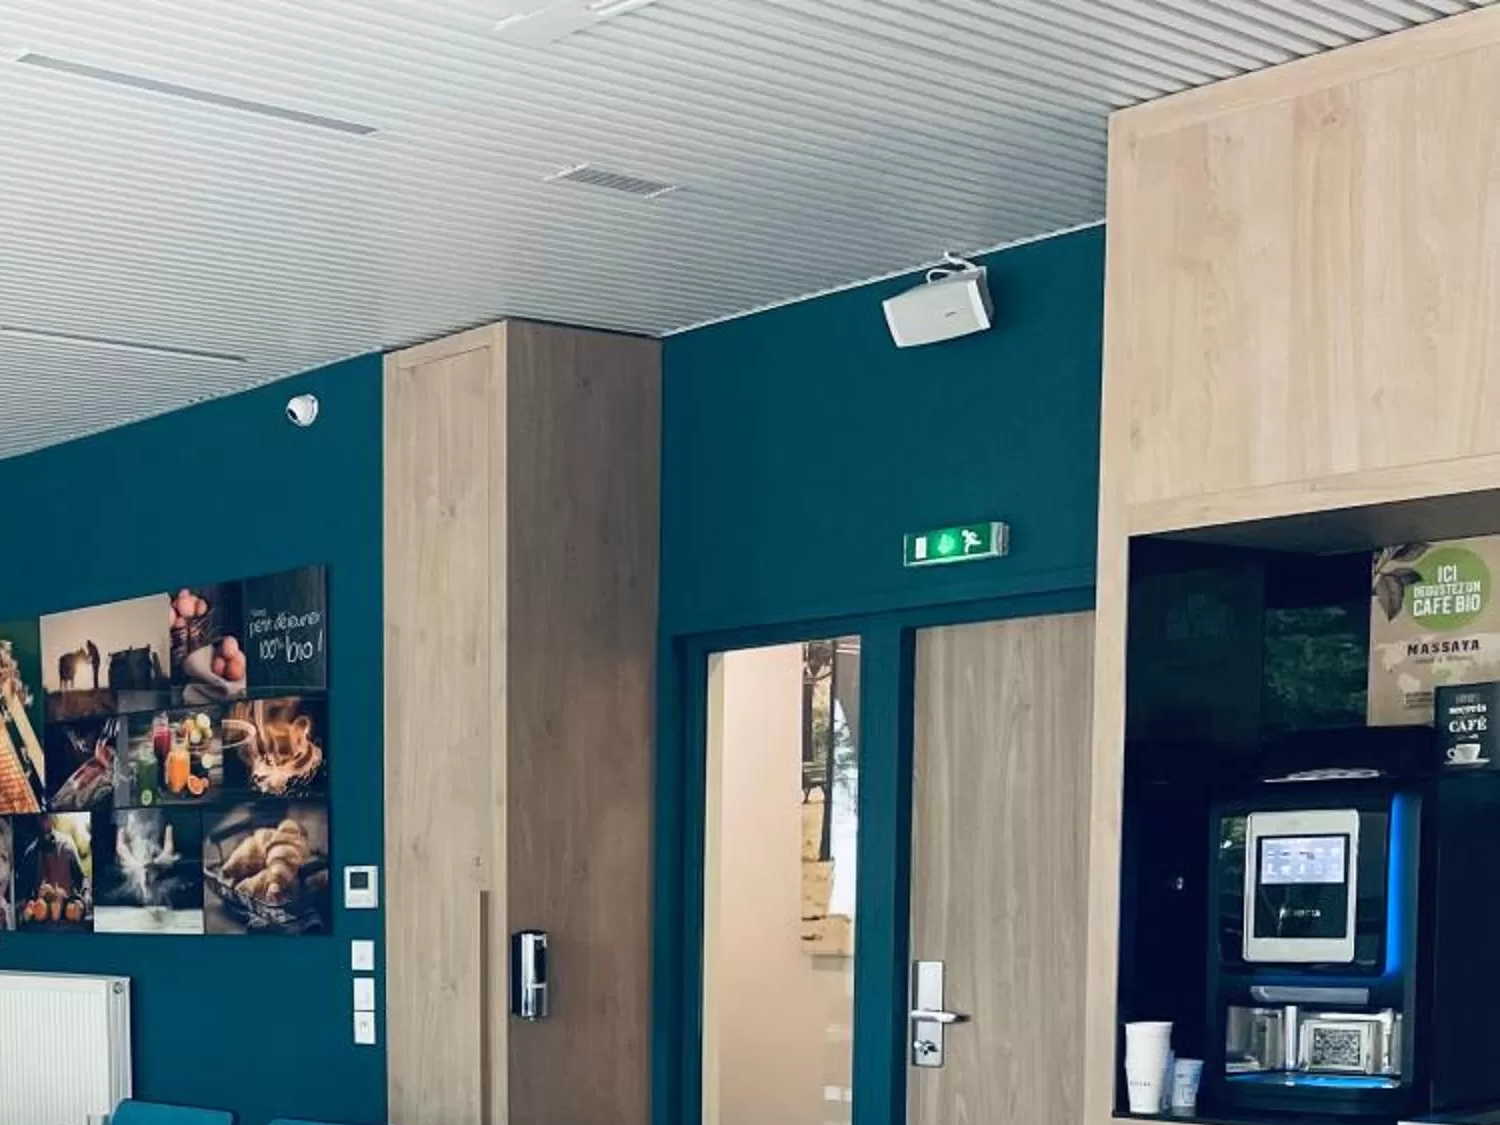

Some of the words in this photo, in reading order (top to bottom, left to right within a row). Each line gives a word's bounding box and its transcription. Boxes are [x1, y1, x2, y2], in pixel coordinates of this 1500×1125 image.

[1437, 564, 1457, 583] ICI
[1455, 593, 1481, 613] BIO
[1407, 639, 1480, 656] MASSAYA
